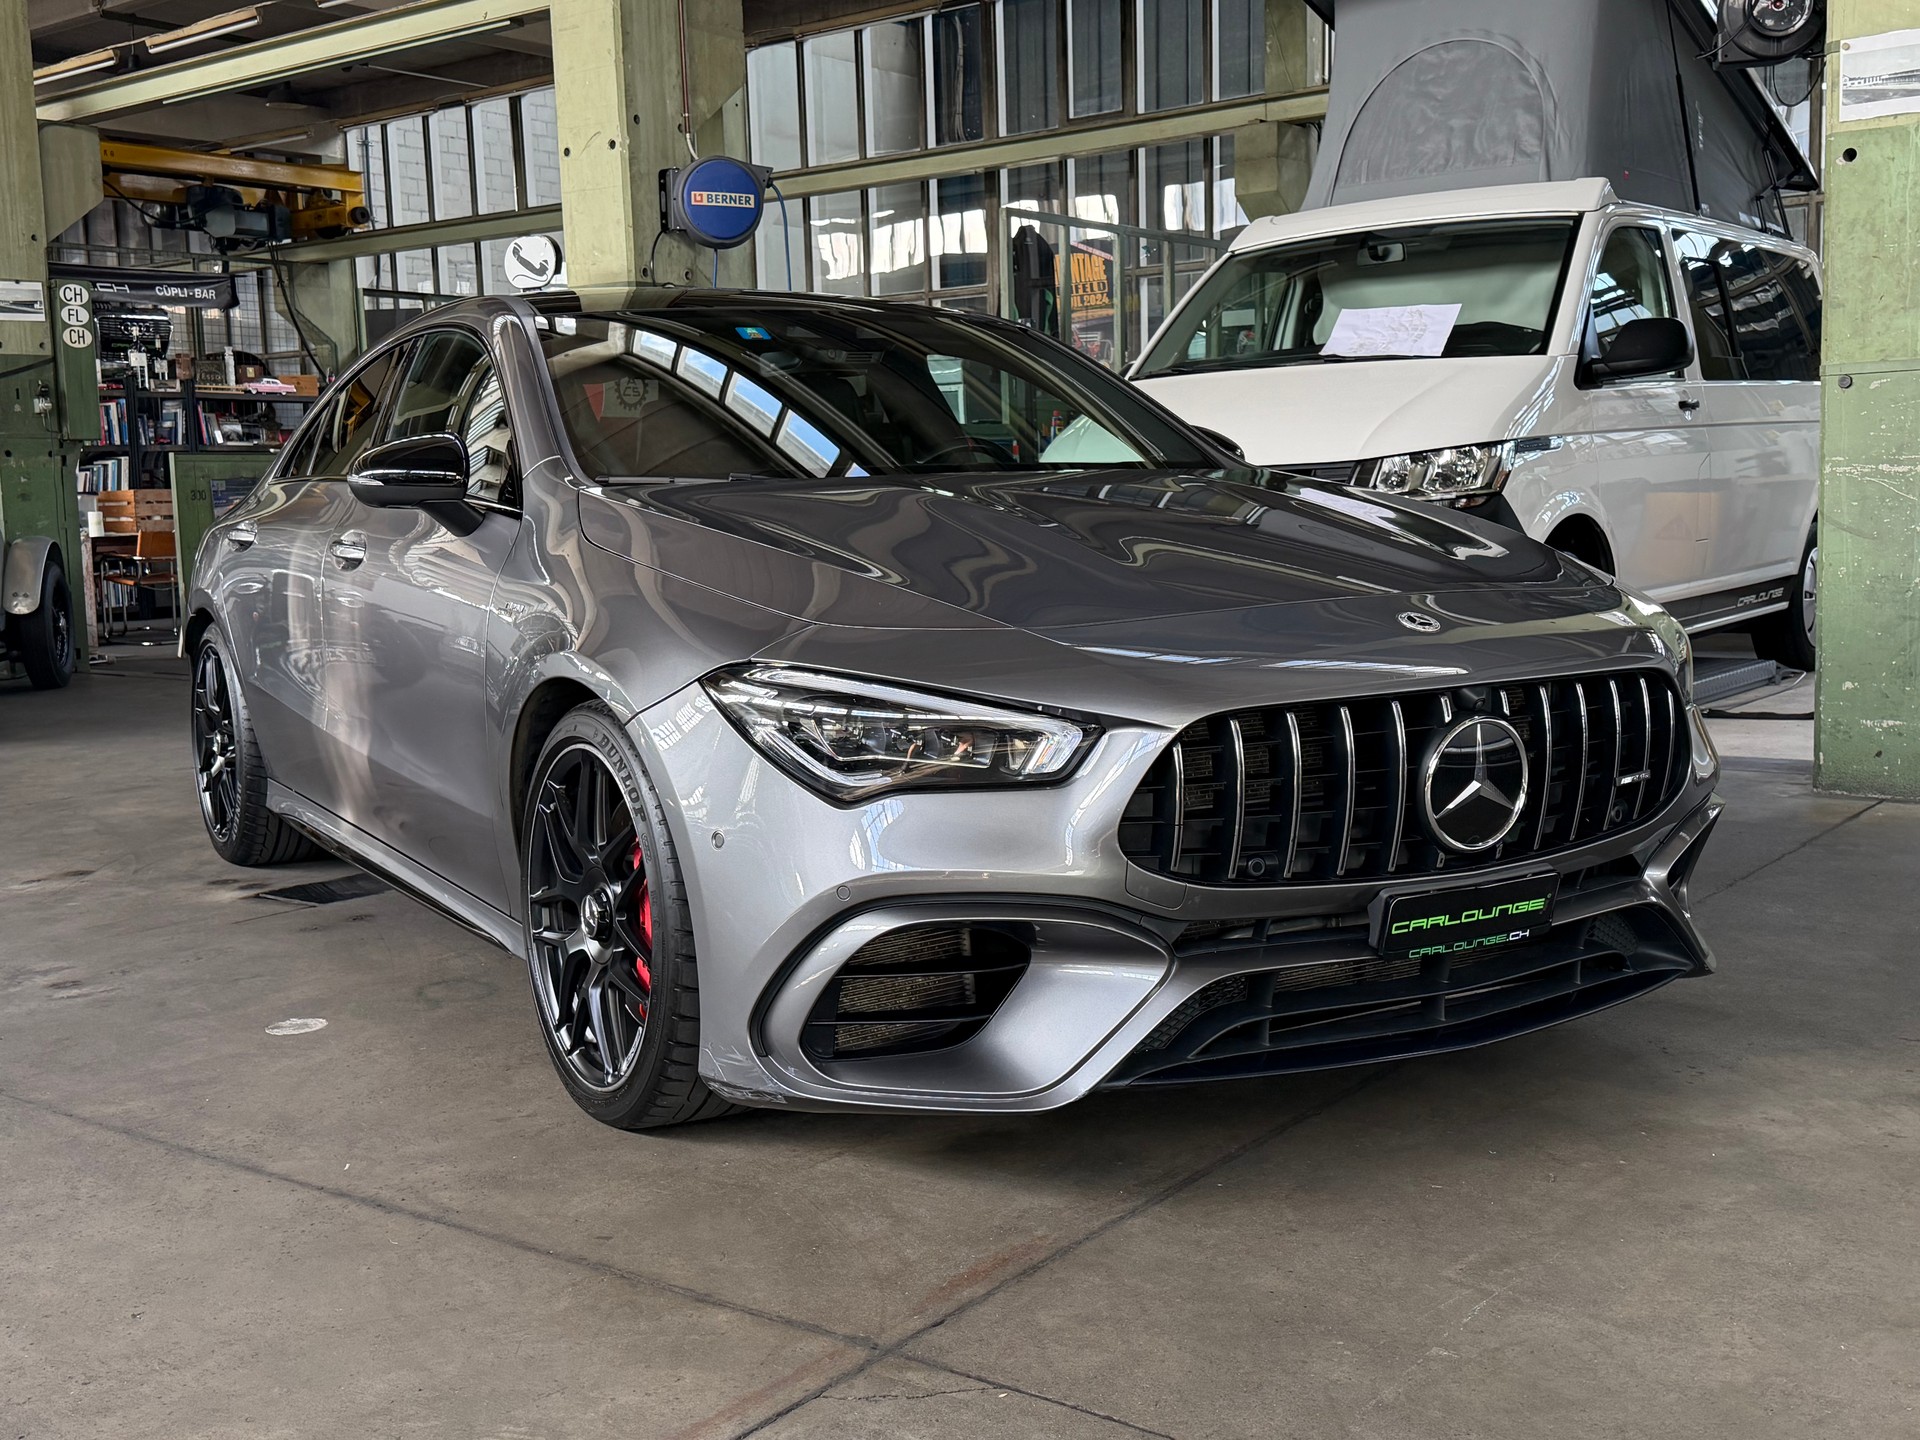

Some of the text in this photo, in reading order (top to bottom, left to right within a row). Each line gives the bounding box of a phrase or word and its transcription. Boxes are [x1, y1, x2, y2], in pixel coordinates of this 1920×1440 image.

[707, 193, 752, 206] BERNER
[64, 286, 83, 303] CH
[90, 283, 130, 293] .CH
[1084, 293, 1111, 306] 2024
[68, 308, 83, 323] FL
[69, 329, 85, 345] CH
[1737, 587, 1785, 607] CARLOUNGE
[600, 733, 646, 823] DUNLOP
[1391, 898, 1546, 935] CARLOUNGE
[1408, 929, 1530, 959] CARLOUNGE.CH
